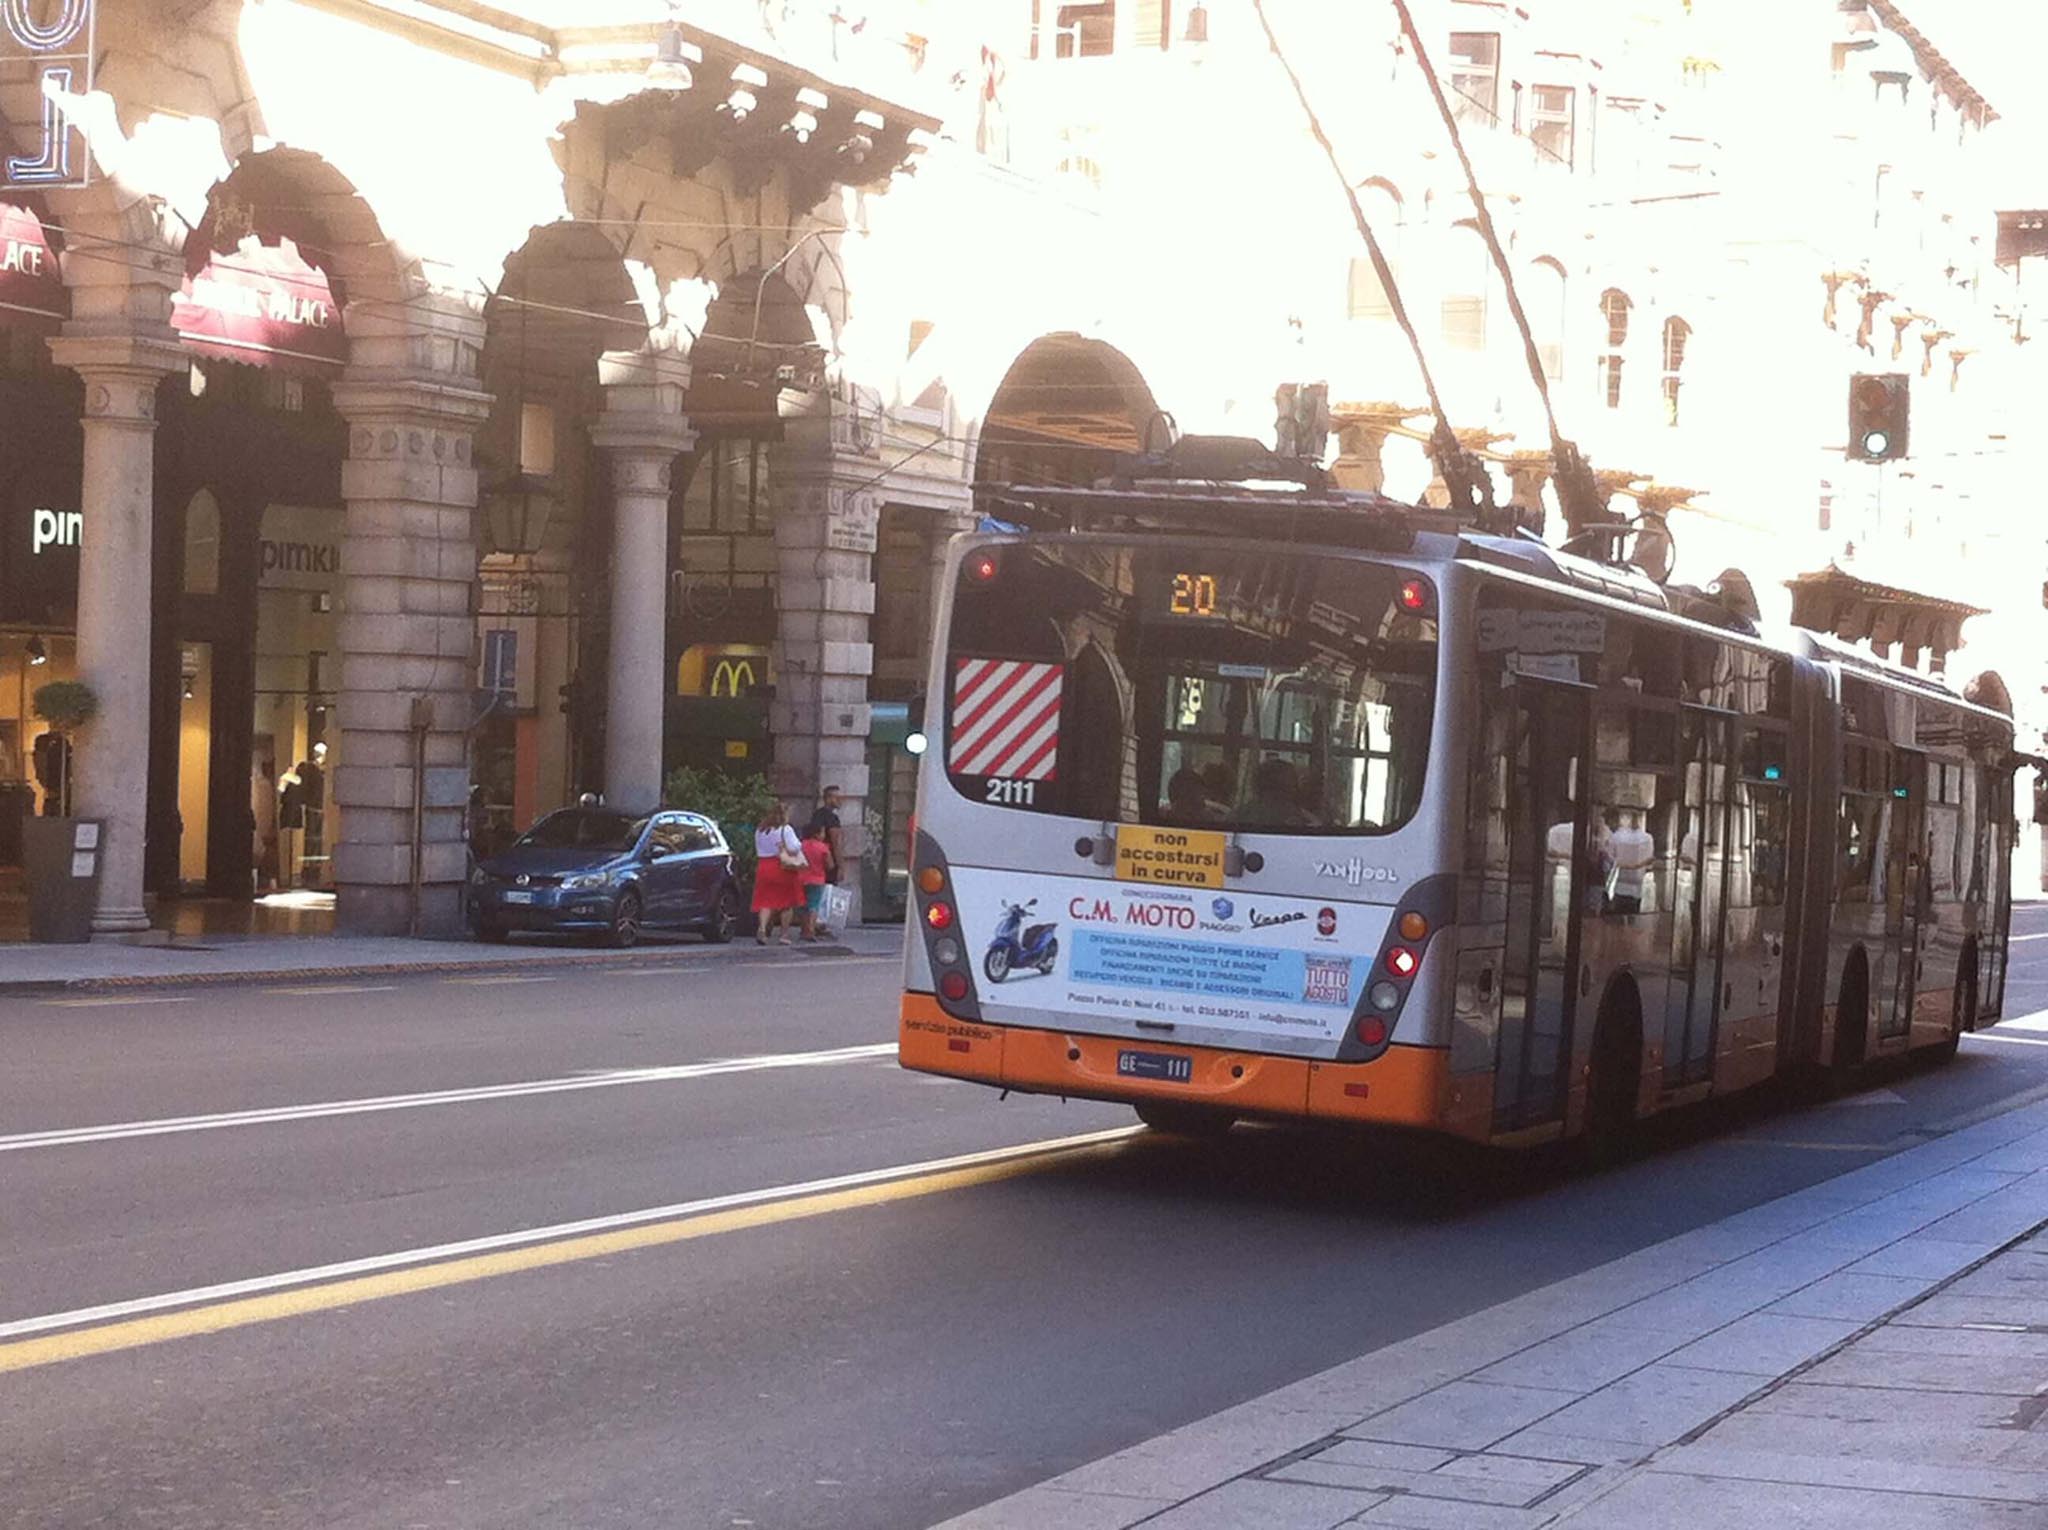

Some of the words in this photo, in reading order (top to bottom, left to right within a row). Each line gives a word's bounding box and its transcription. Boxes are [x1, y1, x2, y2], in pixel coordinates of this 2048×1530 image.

[1170, 573, 1217, 616] 20
[986, 778, 1035, 805] 2111
[1154, 833, 1188, 846] non
[1121, 847, 1219, 867] accostarsi
[1131, 862, 1148, 877] in
[1153, 867, 1206, 883] curva
[1126, 903, 1195, 929] MOTO
[1249, 907, 1308, 929] Vespa
